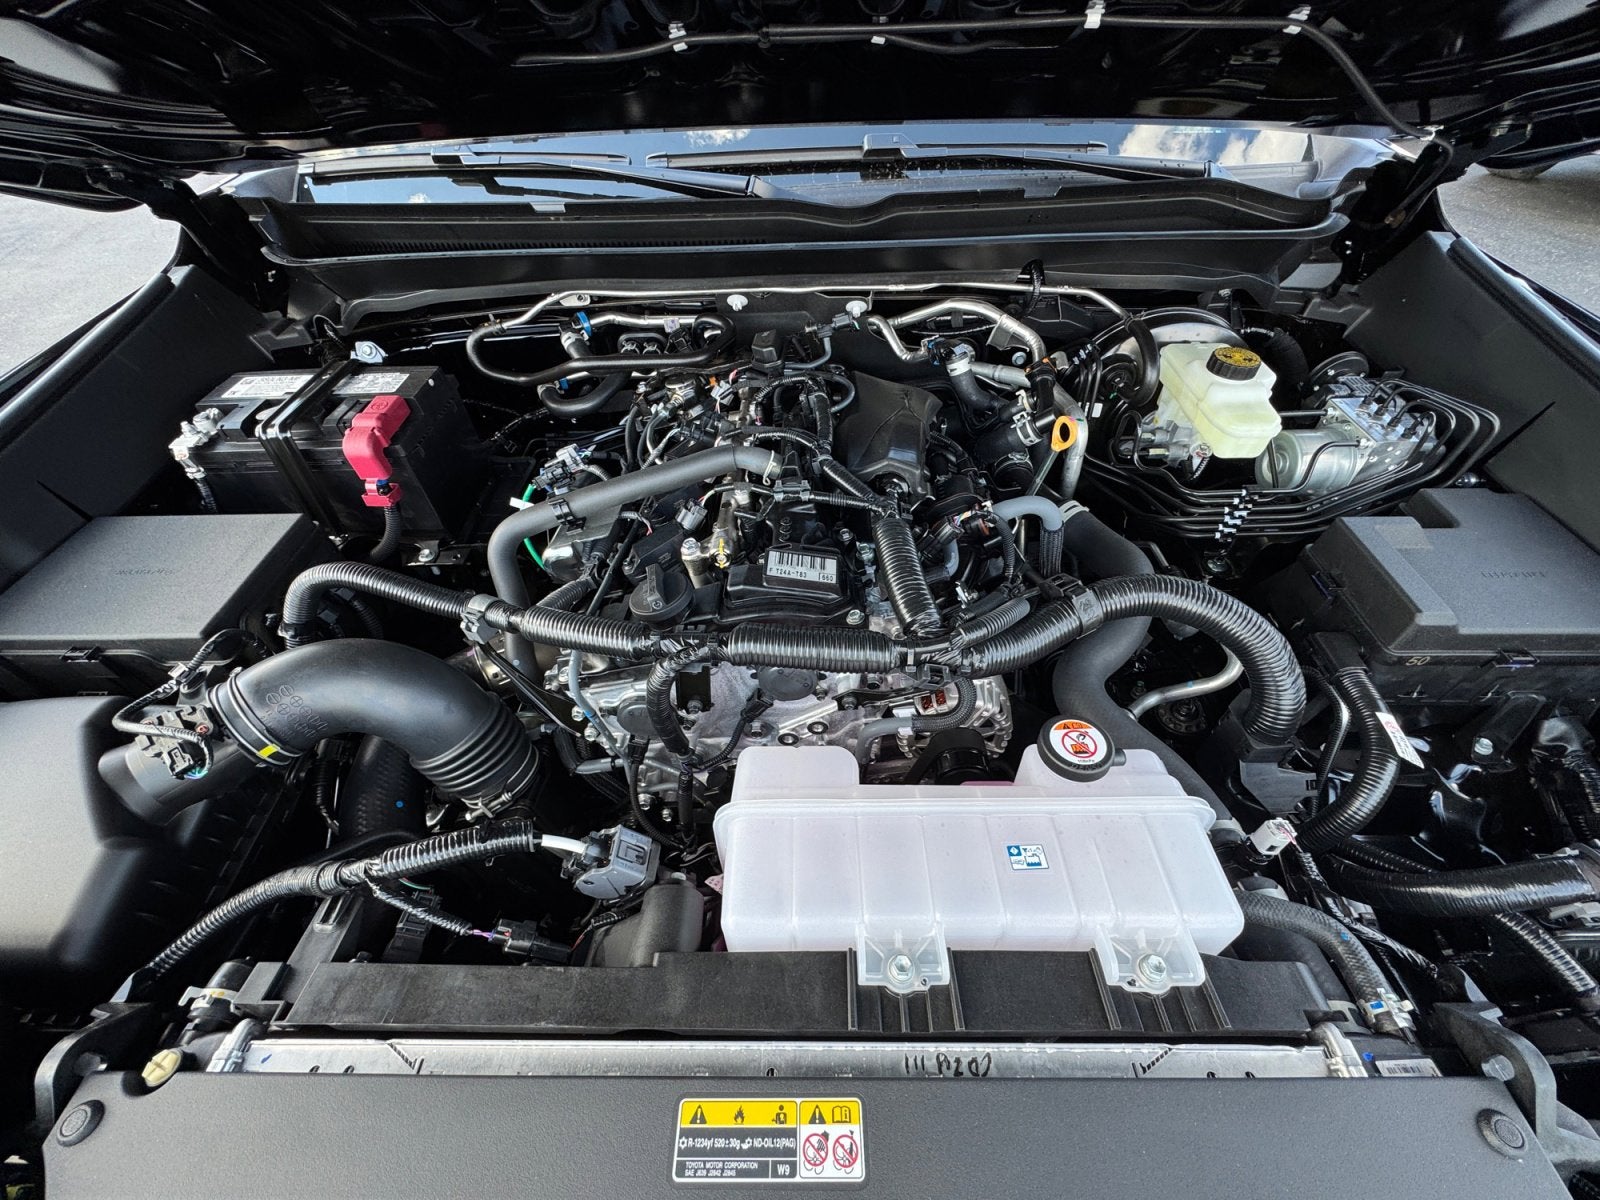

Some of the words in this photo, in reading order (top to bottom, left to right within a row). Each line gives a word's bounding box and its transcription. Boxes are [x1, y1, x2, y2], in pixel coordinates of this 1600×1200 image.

[1405, 656, 1430, 666] 50
[687, 1137, 714, 1150] R-1234yf
[753, 1137, 796, 1150] ND-OIL12(PAG)
[685, 1161, 705, 1169] TOYOTA
[705, 1161, 723, 1169] MOTOR
[724, 1161, 758, 1169] CORPORATION
[777, 1164, 790, 1176] W9
